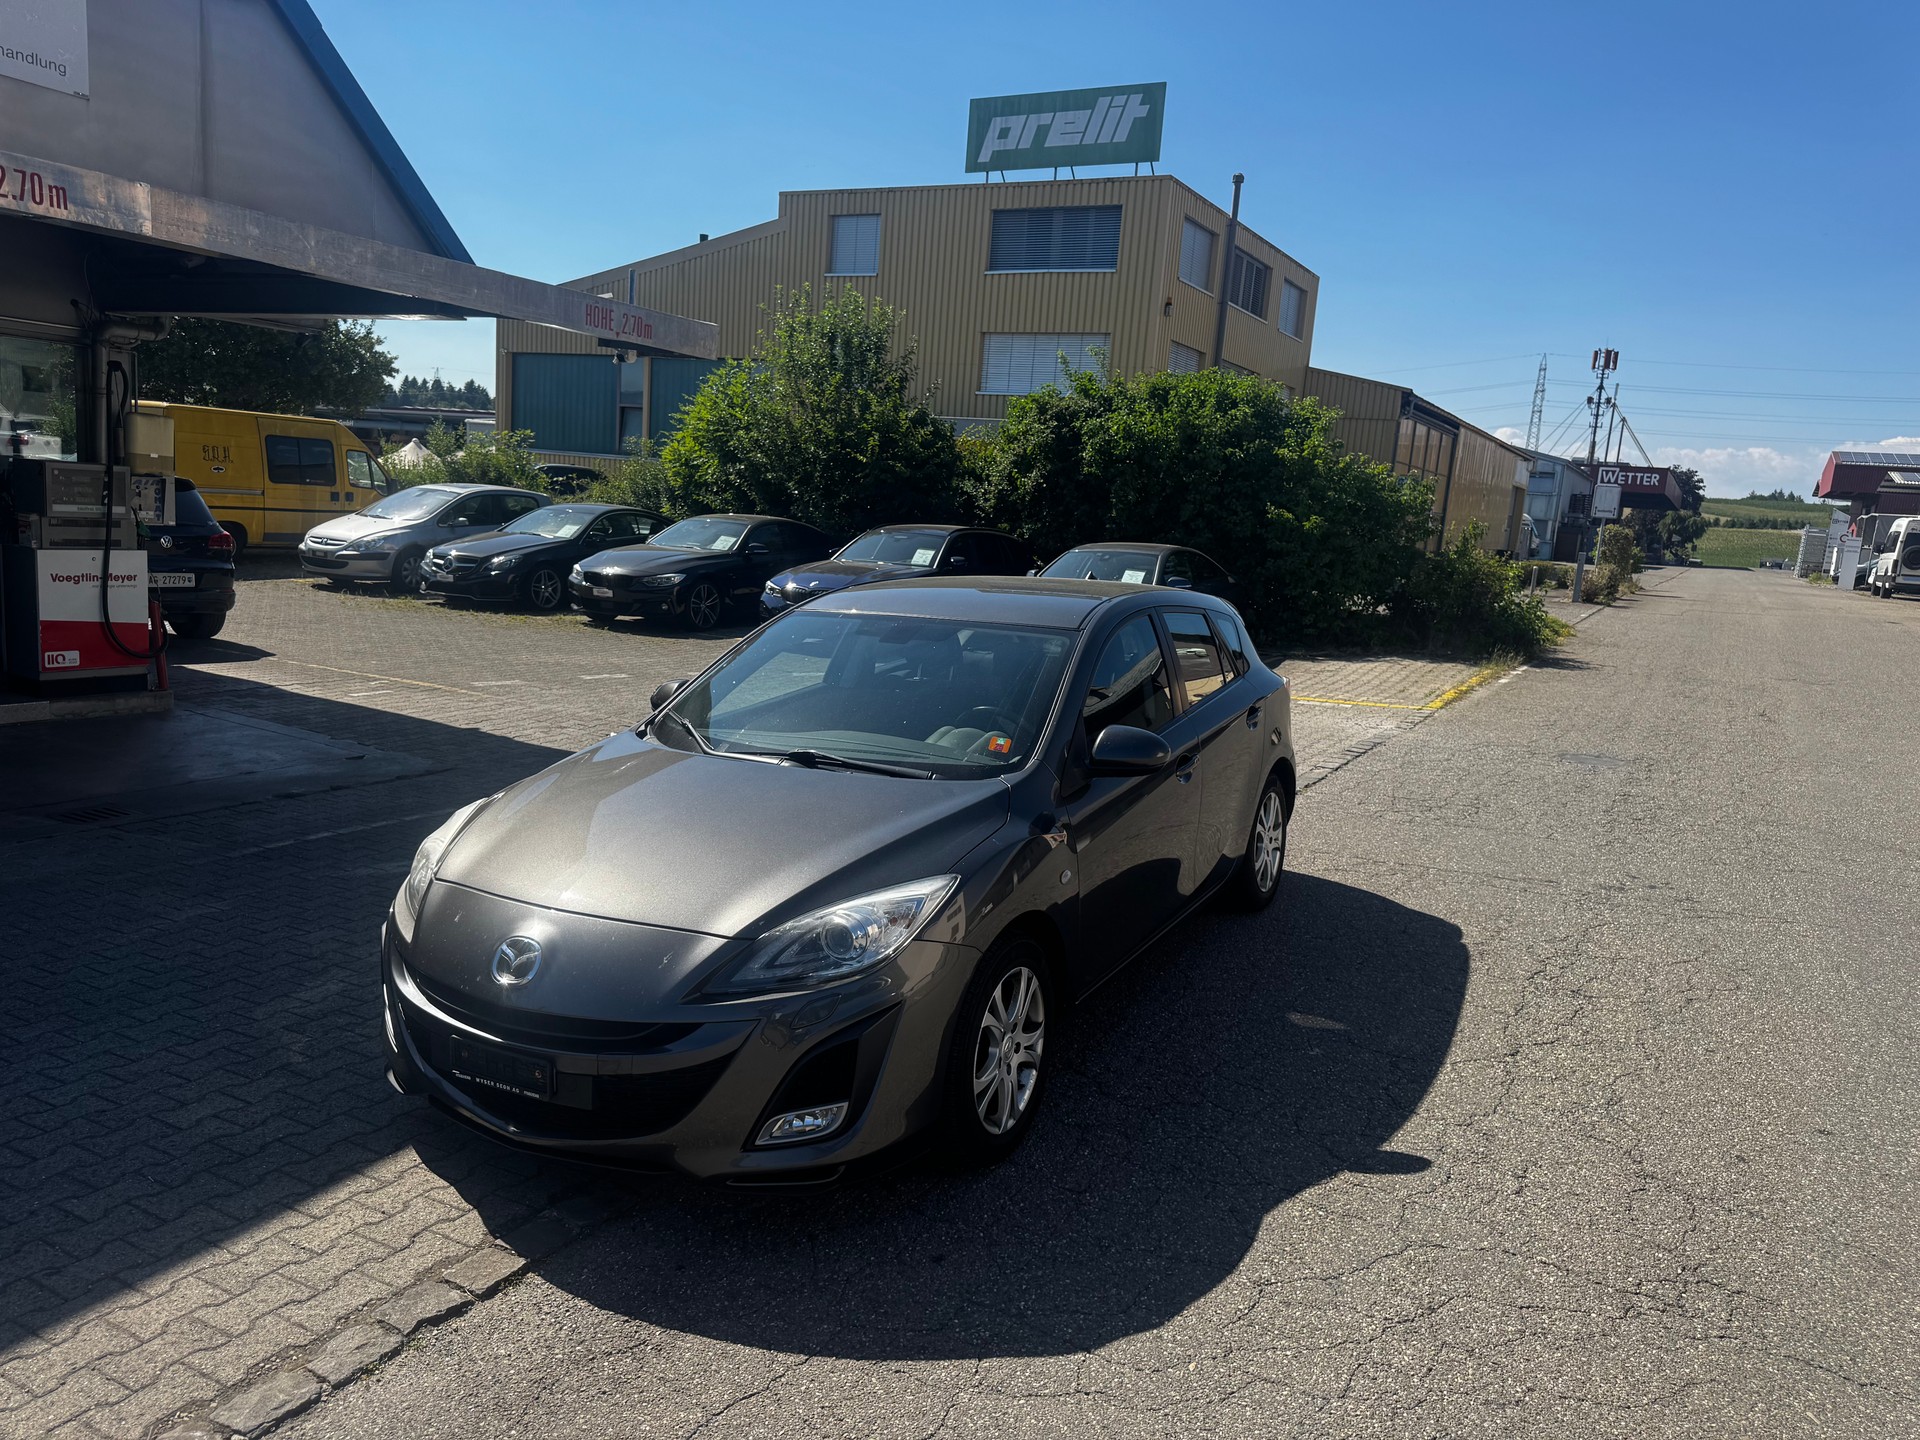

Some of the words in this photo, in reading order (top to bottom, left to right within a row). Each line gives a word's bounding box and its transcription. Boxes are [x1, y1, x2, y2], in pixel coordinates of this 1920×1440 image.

[977, 94, 1150, 162] prelit
[1601, 468, 1660, 486] WETTER
[162, 575, 187, 585] 27279
